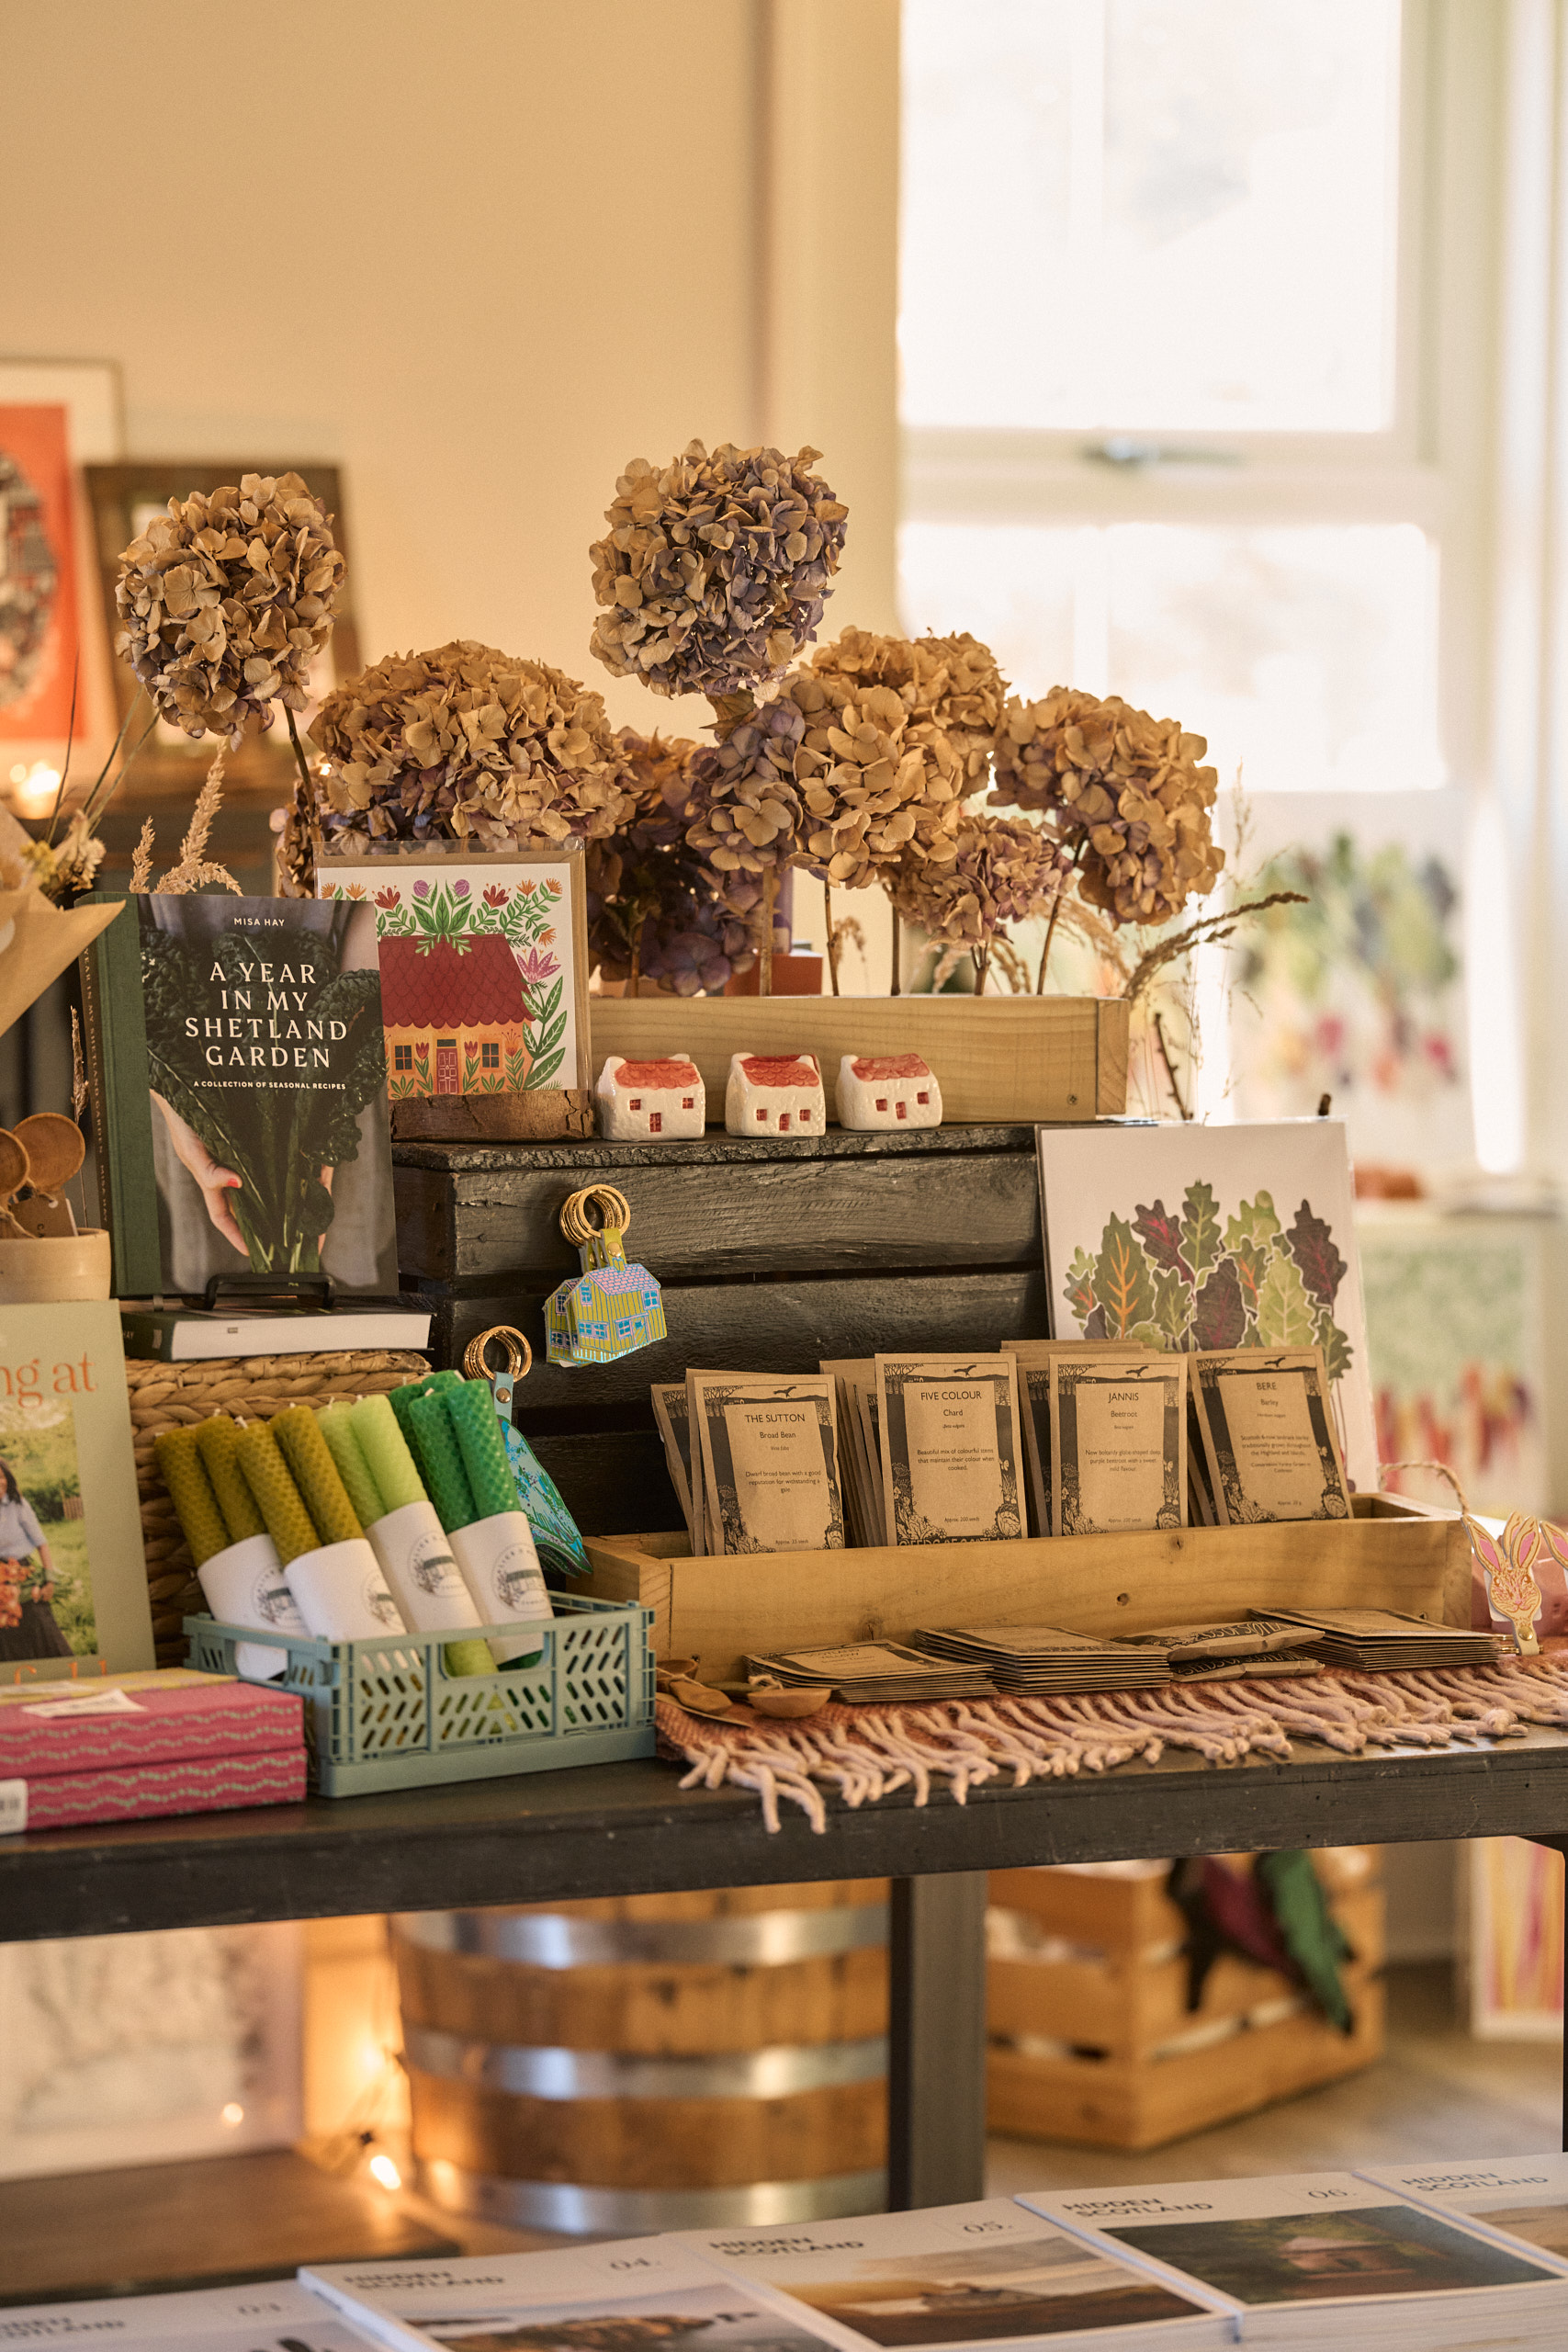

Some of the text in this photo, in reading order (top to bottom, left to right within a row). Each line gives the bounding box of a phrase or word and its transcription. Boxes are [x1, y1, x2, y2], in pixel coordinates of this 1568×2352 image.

[234, 918, 285, 927] MISA HAY
[209, 962, 316, 984] A YEAR
[86, 986, 92, 1000] IN
[221, 989, 308, 1011] IN MY
[88, 1004, 94, 1022] MY
[185, 1017, 347, 1040] SHETLAND
[206, 1046, 330, 1068] GARDEN
[95, 1101, 104, 1154] GARDEN
[52, 1351, 98, 1394] at
[1257, 1382, 1277, 1391] BERE
[920, 1390, 982, 1401] FIVE COLOUR
[1108, 1392, 1139, 1404] JANNIS
[744, 1413, 806, 1423] THE SUTTON
[781, 1430, 796, 1439] Bean
[1402, 2173, 1499, 2185] HIDDEN
[1417, 2177, 1549, 2191] SCOTLAND
[1062, 2198, 1163, 2211] HIDDEN
[1077, 2203, 1213, 2217] SCOTLAND
[709, 2237, 814, 2249] HIDDEN
[723, 2241, 863, 2256] SCOTLAND
